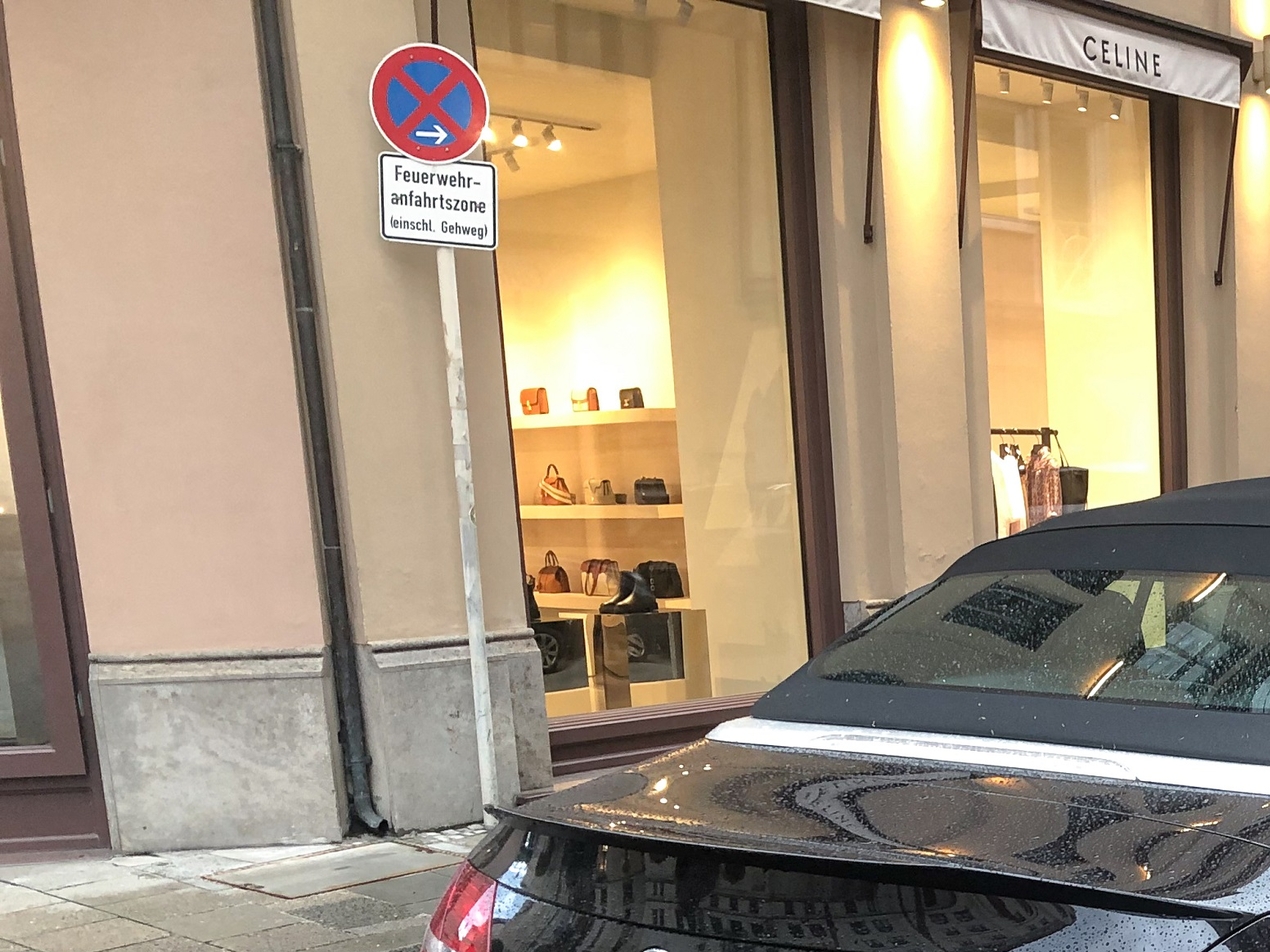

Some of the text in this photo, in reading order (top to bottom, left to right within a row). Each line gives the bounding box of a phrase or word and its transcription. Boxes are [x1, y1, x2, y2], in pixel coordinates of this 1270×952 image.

[1083, 36, 1162, 77] CELINE
[394, 165, 481, 189] Feuerwehr-
[390, 190, 486, 214] anfahrtszone
[390, 215, 488, 240] (einschl. Gehweg)
